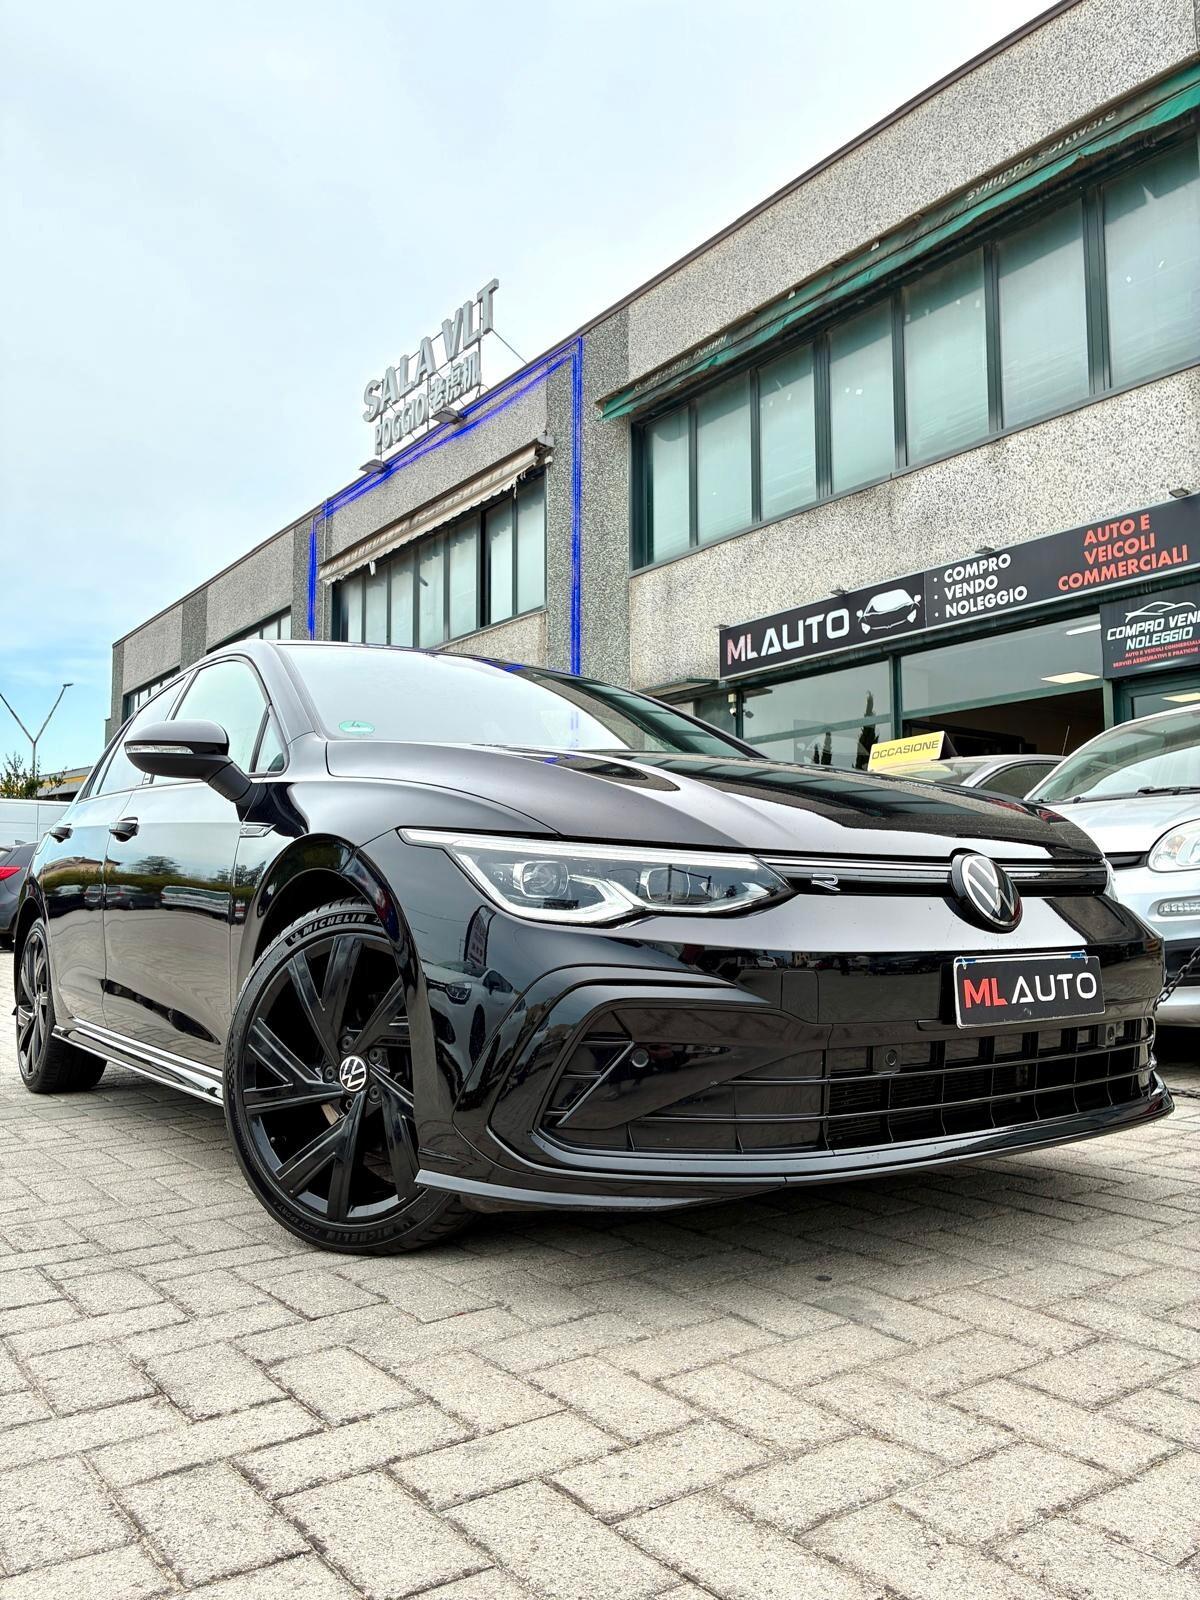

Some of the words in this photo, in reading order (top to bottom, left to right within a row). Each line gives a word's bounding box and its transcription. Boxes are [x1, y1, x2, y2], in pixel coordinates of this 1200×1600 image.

[363, 336, 436, 423] SALA
[442, 278, 499, 362] VLT
[375, 393, 428, 456] POGGIO
[1083, 517, 1135, 546] AUTO
[1140, 514, 1150, 531] E
[1083, 533, 1155, 565] VEICOLI
[943, 553, 1011, 584] COMPRO
[1057, 544, 1188, 591] COMMERCIALI
[944, 575, 998, 600] VENDO
[945, 585, 1028, 618] NOLEGGIO
[1106, 618, 1165, 641] COMPRO
[1126, 626, 1193, 650] NOLEGGIO
[871, 739, 940, 760] OCCASIONE
[303, 914, 367, 936] MICHELIN
